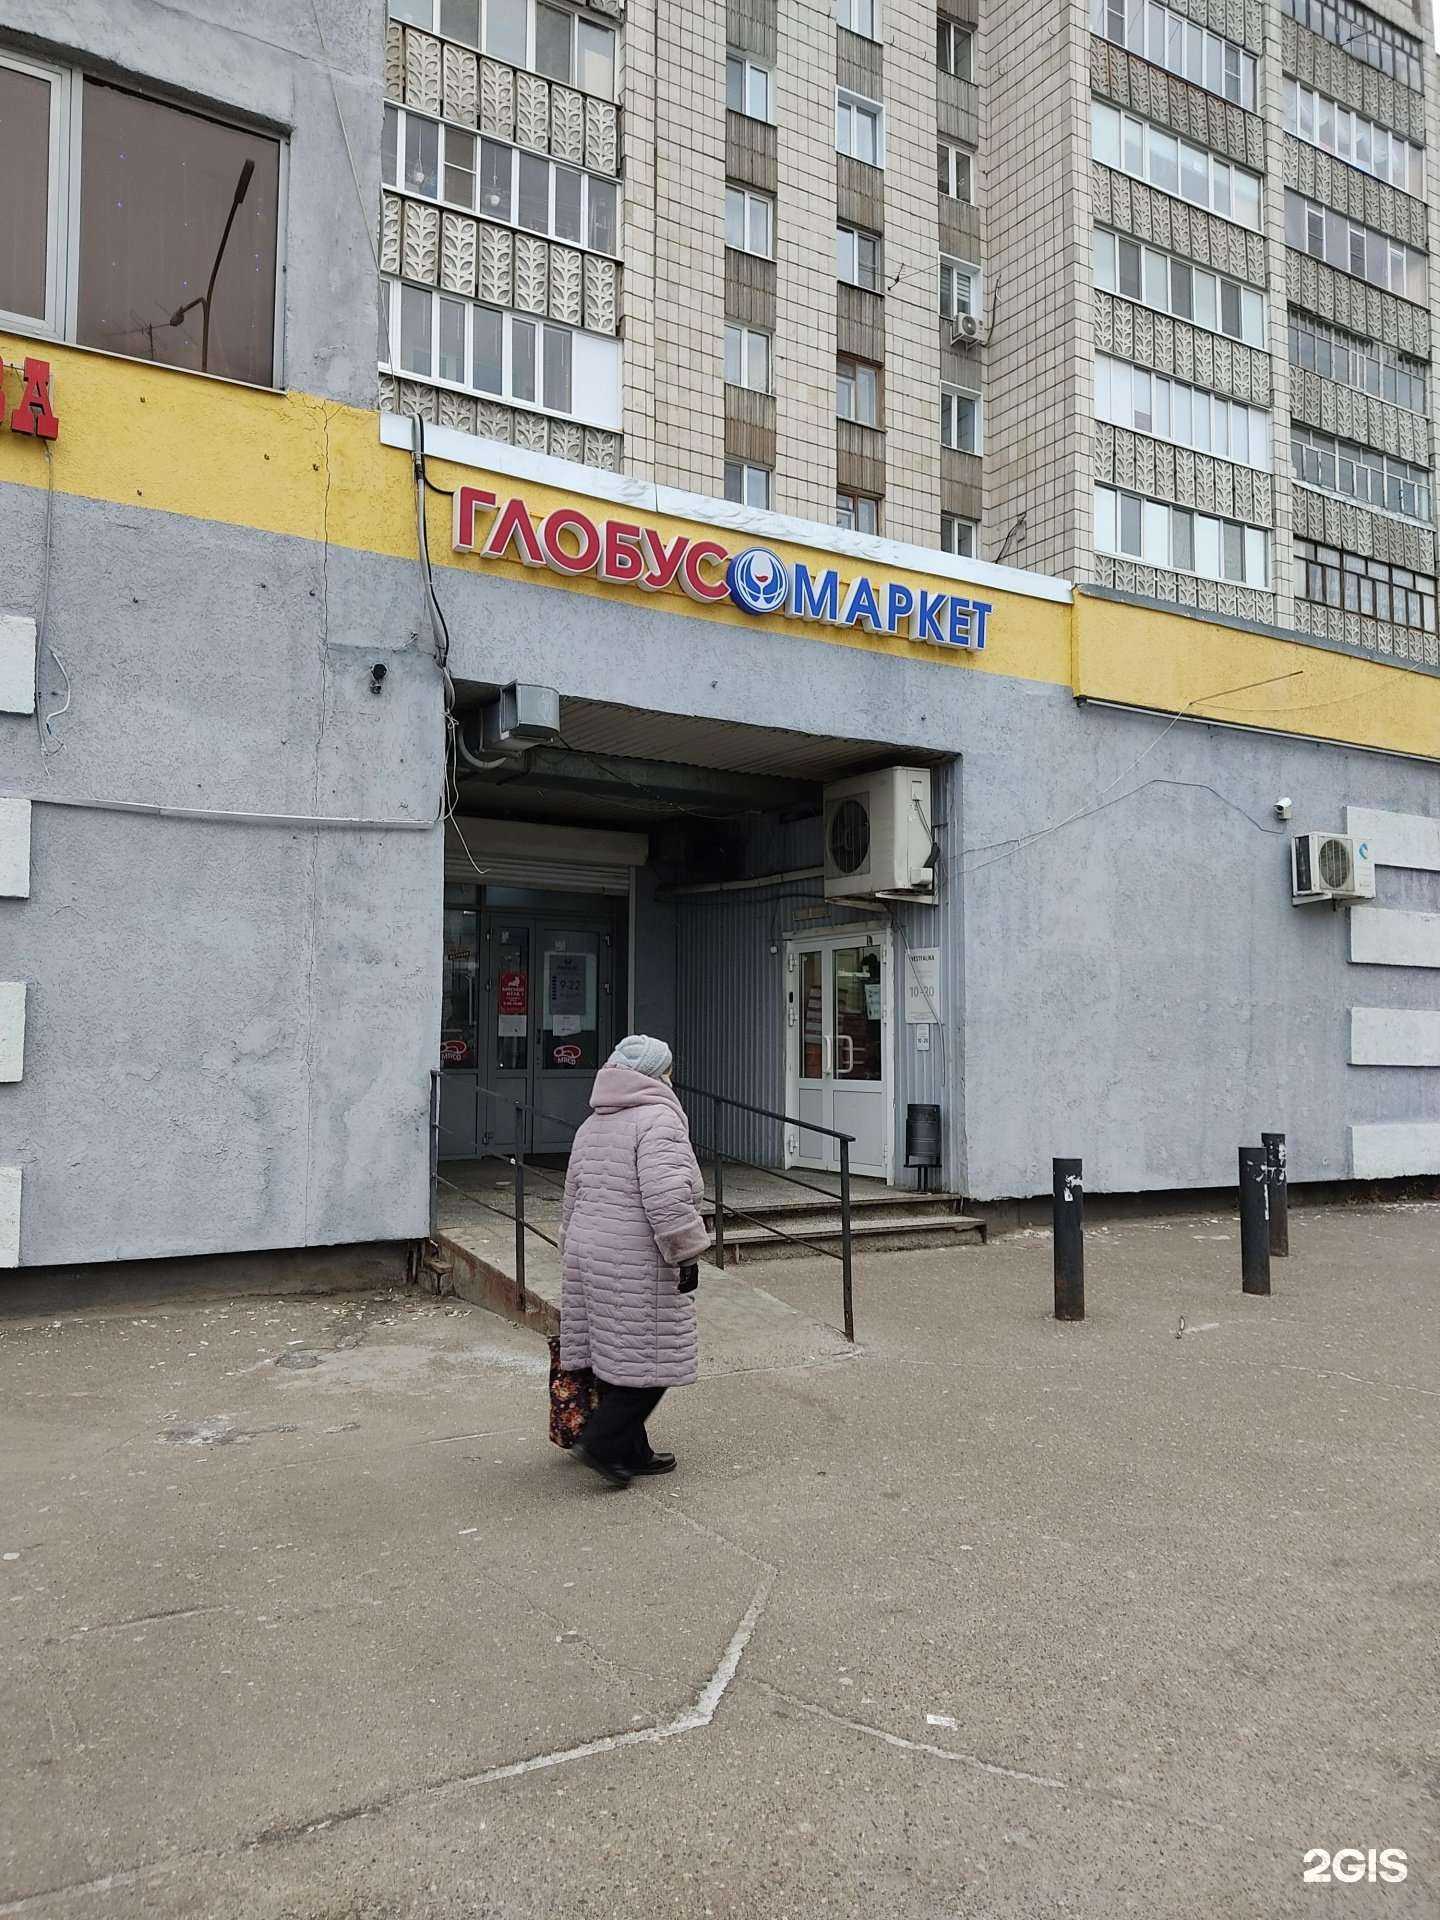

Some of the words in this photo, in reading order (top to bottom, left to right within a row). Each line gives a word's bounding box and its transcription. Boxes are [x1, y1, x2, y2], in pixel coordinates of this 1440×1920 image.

[0, 354, 59, 441] А
[453, 486, 732, 603] ГЛОБУС
[786, 563, 992, 652] МАРКЕТ
